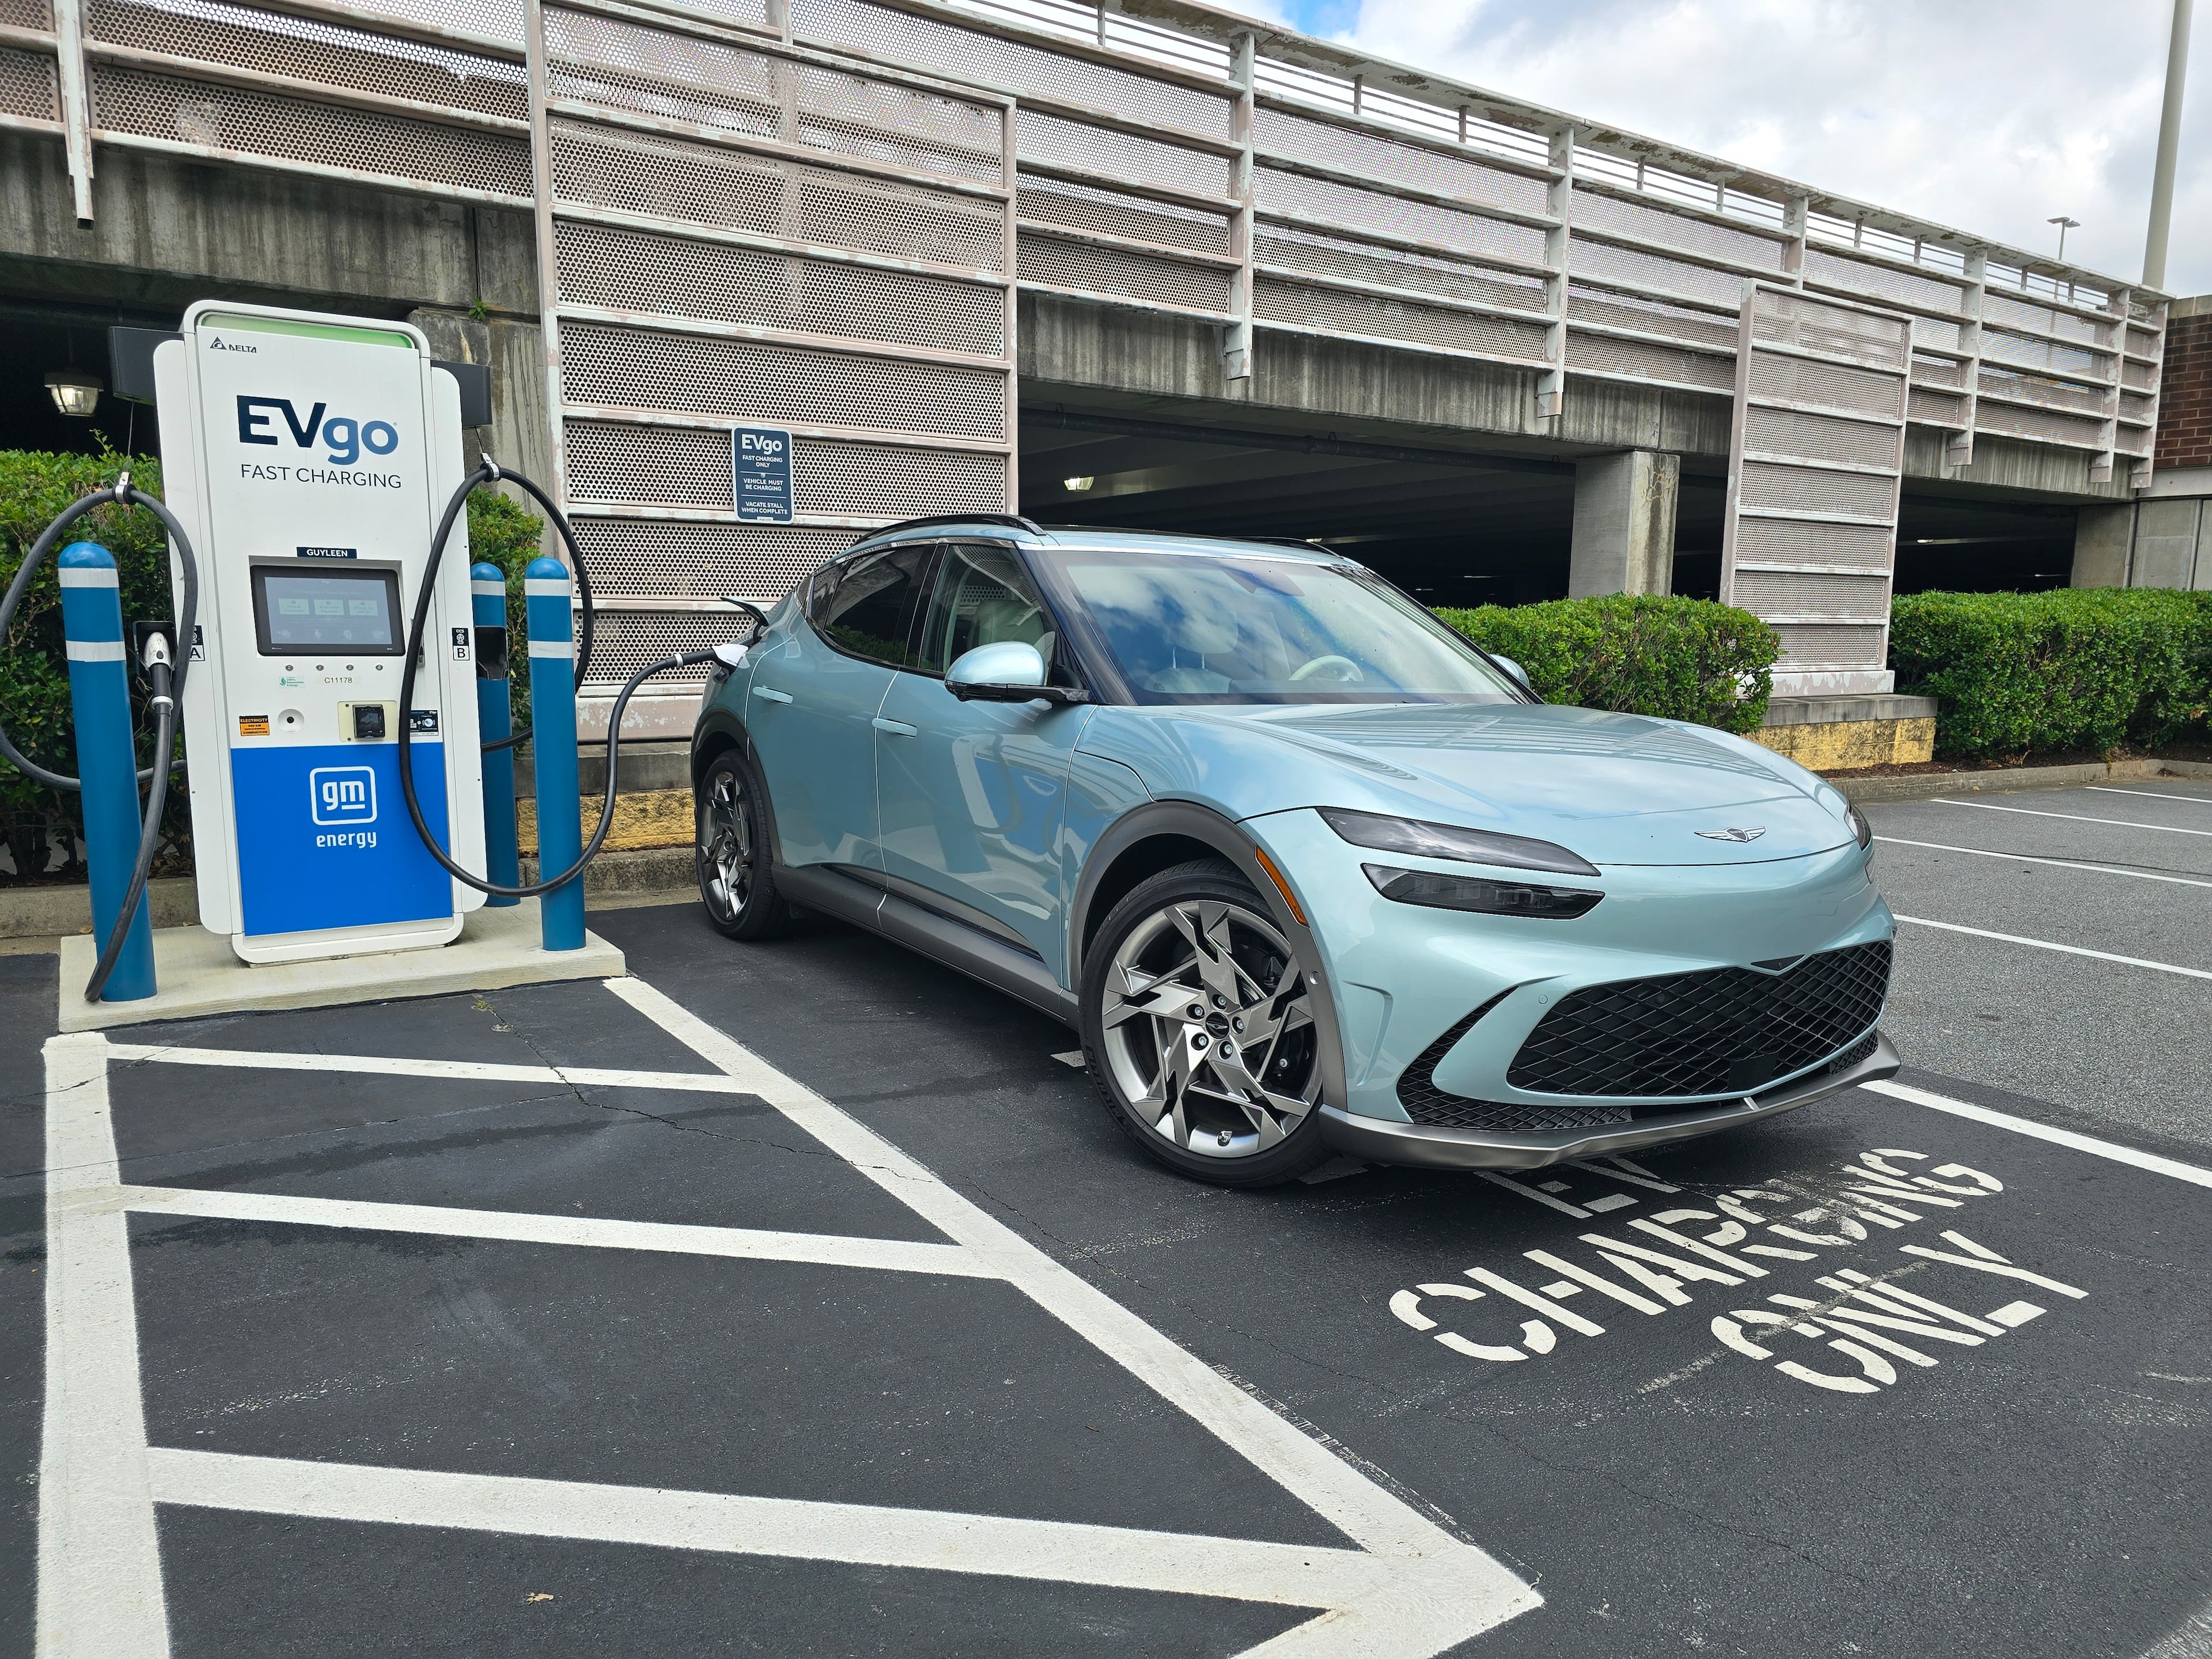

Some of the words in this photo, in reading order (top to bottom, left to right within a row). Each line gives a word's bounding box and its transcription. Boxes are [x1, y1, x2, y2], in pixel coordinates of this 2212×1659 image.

[229, 344, 257, 353] DELTA
[237, 395, 399, 465] EVgo
[741, 434, 783, 454] EVgo
[241, 464, 290, 480] FAST
[296, 468, 402, 488] CHARGING
[306, 549, 348, 557] GUYLEEN
[190, 647, 201, 658] A
[457, 648, 465, 658] B
[323, 781, 366, 810] gm
[316, 832, 377, 849] energy
[1388, 1148, 2005, 1362] CHARGING
[1710, 1229, 2089, 1394] ONLY
